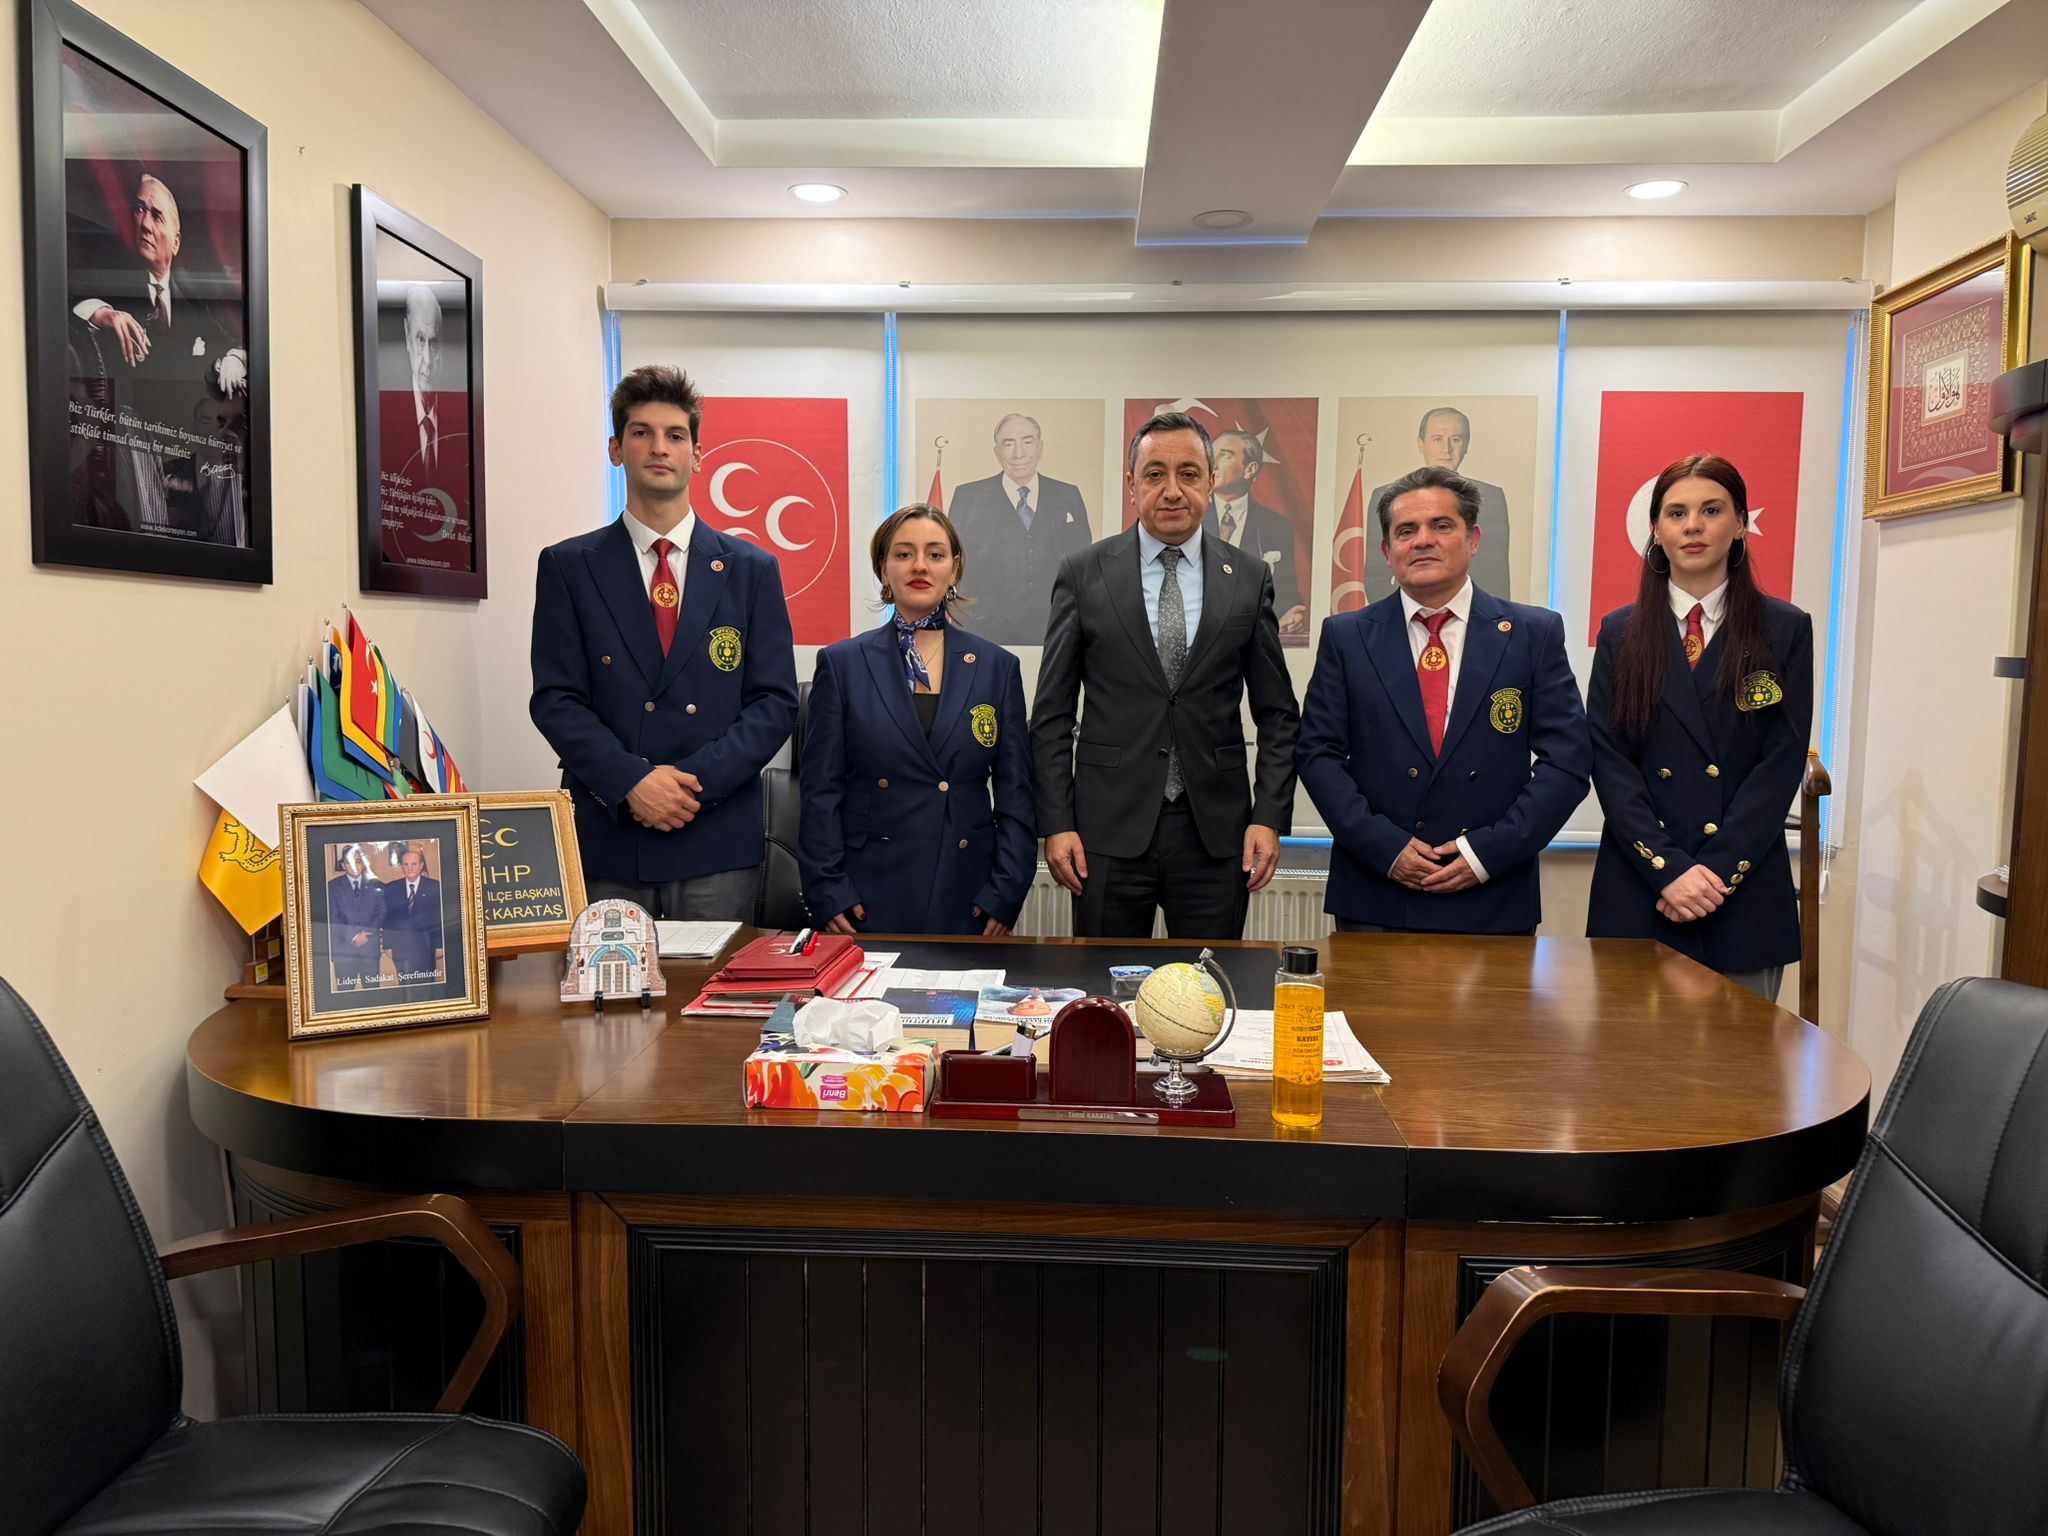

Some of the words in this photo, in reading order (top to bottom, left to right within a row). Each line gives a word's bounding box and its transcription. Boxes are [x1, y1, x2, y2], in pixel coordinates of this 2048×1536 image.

[68, 401, 83, 415] Biz
[84, 404, 117, 424] Türkler,
[119, 412, 143, 430] bütün
[144, 420, 178, 438] tarihimiz
[178, 427, 207, 445] boyunca
[207, 434, 233, 453] hürriyet
[234, 445, 242, 454] ve
[102, 429, 129, 445] timsal
[128, 435, 152, 454] olmuş
[152, 440, 164, 453] bir
[164, 444, 191, 460] milletiz
[487, 890, 513, 904] İLÇE
[515, 887, 561, 901] BAŞKANI
[493, 904, 564, 920] KARATAŞ
[336, 976, 362, 986] Lidere
[364, 973, 394, 984] Sadakat
[398, 969, 442, 982] Şerefimizdir
